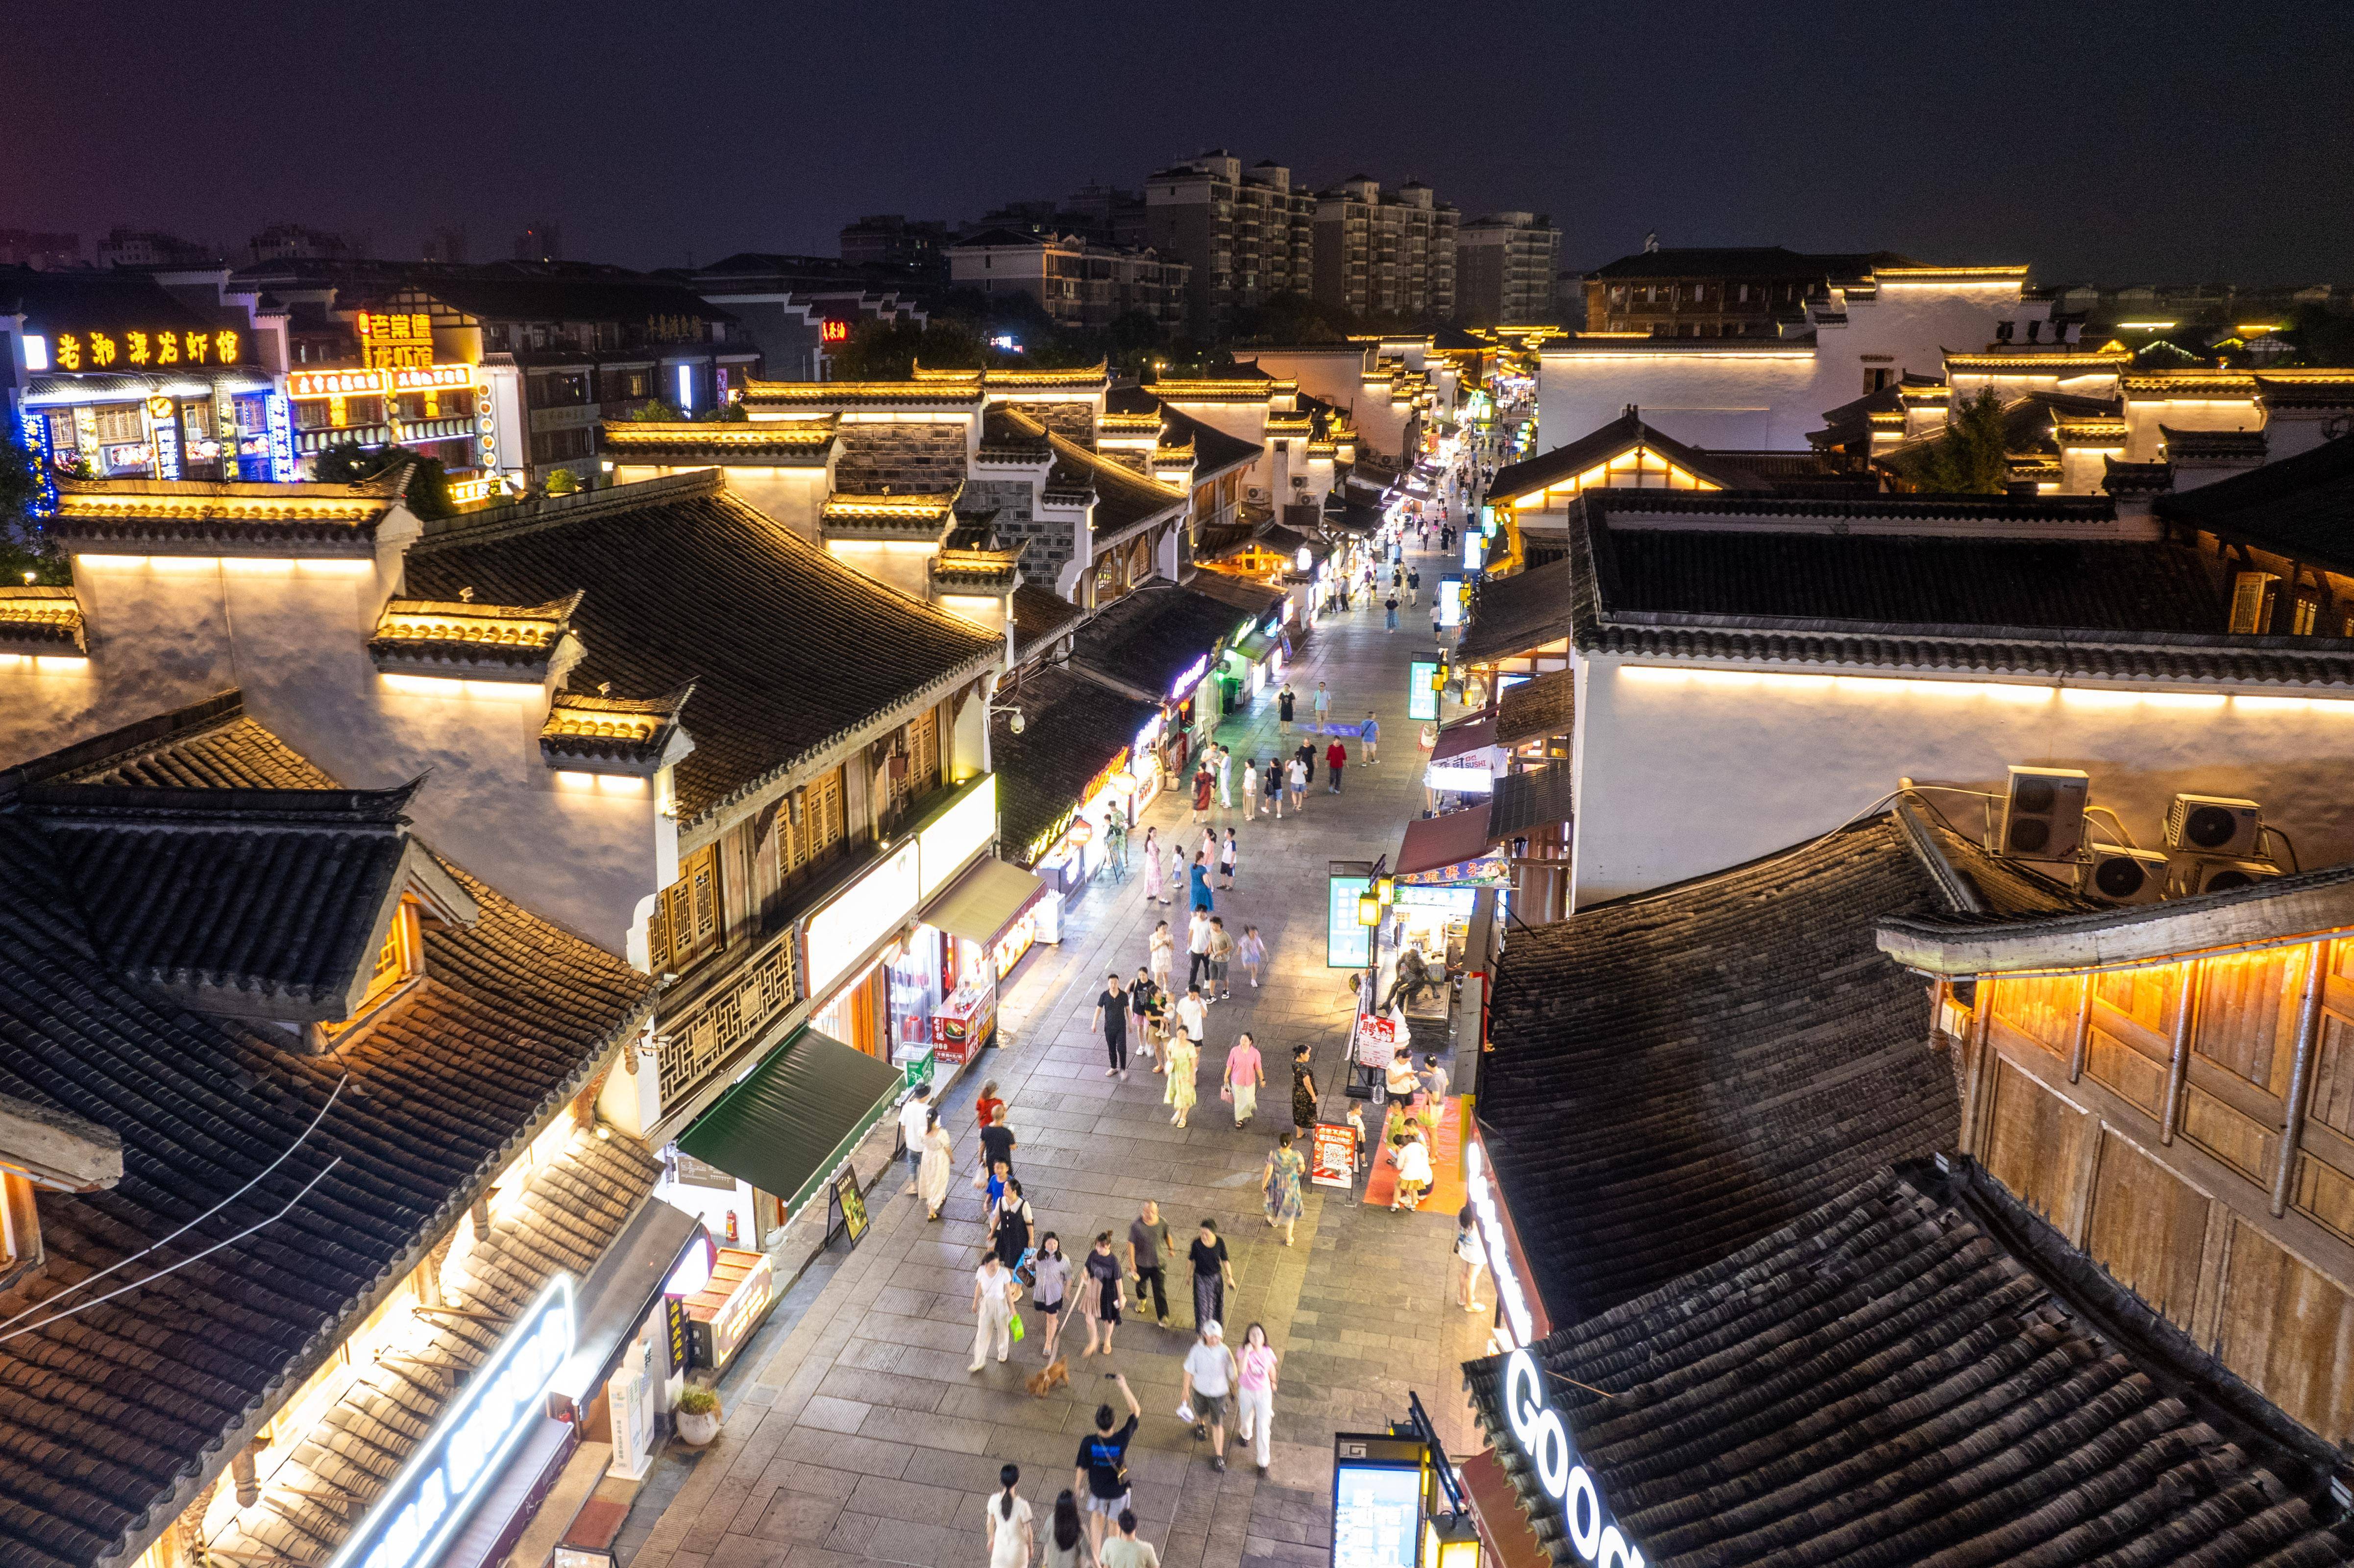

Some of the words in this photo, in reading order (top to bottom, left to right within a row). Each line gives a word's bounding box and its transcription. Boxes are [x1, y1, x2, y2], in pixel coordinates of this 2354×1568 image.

[369, 314, 431, 338] 老常德
[56, 331, 239, 369] 老湘潭龙虾馆
[373, 346, 434, 368] 龙虾馆
[1465, 760, 1486, 768] SUSHI
[1362, 1021, 1376, 1036] 聘
